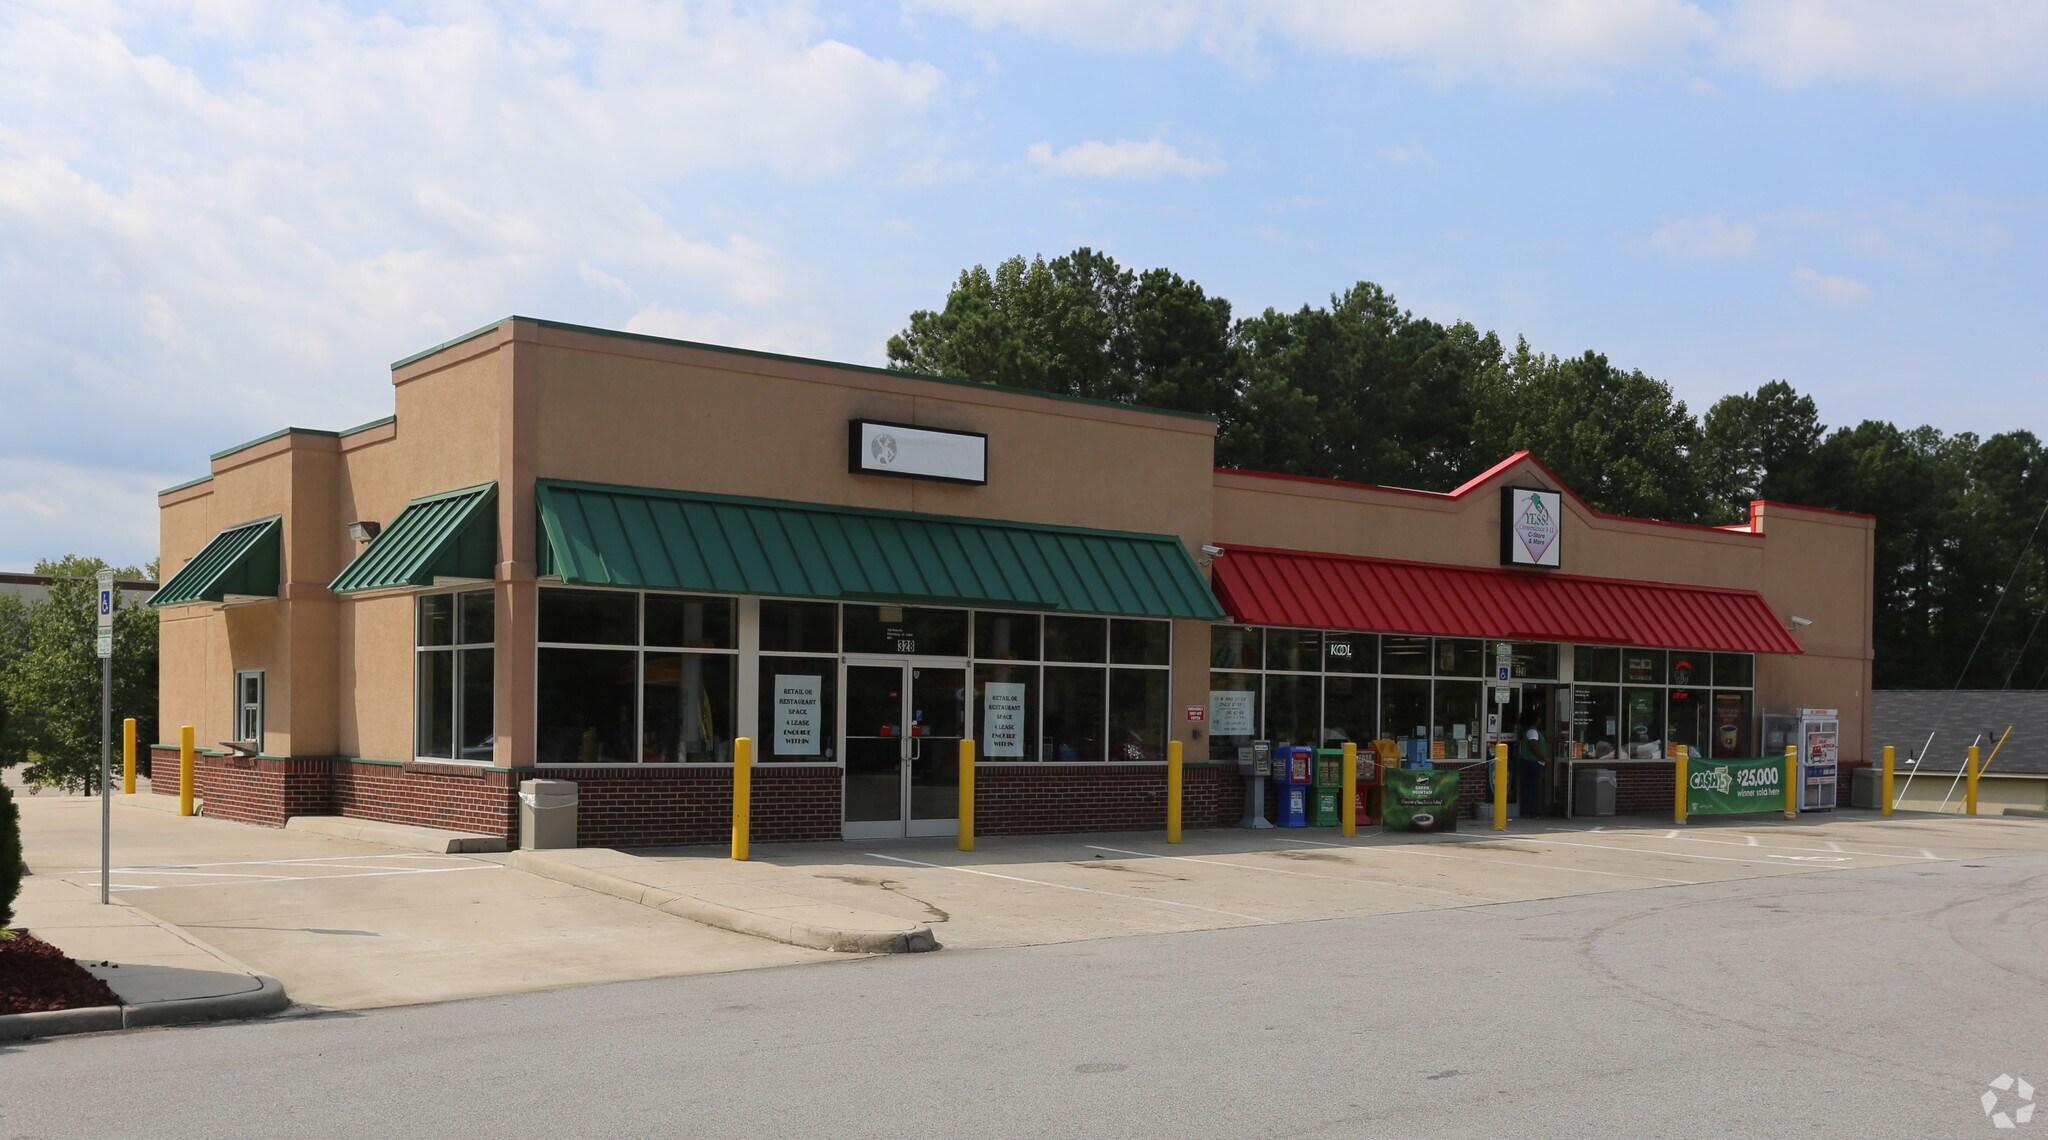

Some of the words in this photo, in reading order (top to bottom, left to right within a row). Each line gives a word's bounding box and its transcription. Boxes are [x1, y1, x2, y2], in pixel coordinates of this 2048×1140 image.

[1525, 509, 1548, 526] YESS!
[898, 640, 914, 652] 328
[1330, 644, 1352, 656] KOOL
[1737, 767, 1778, 787] $25,000
